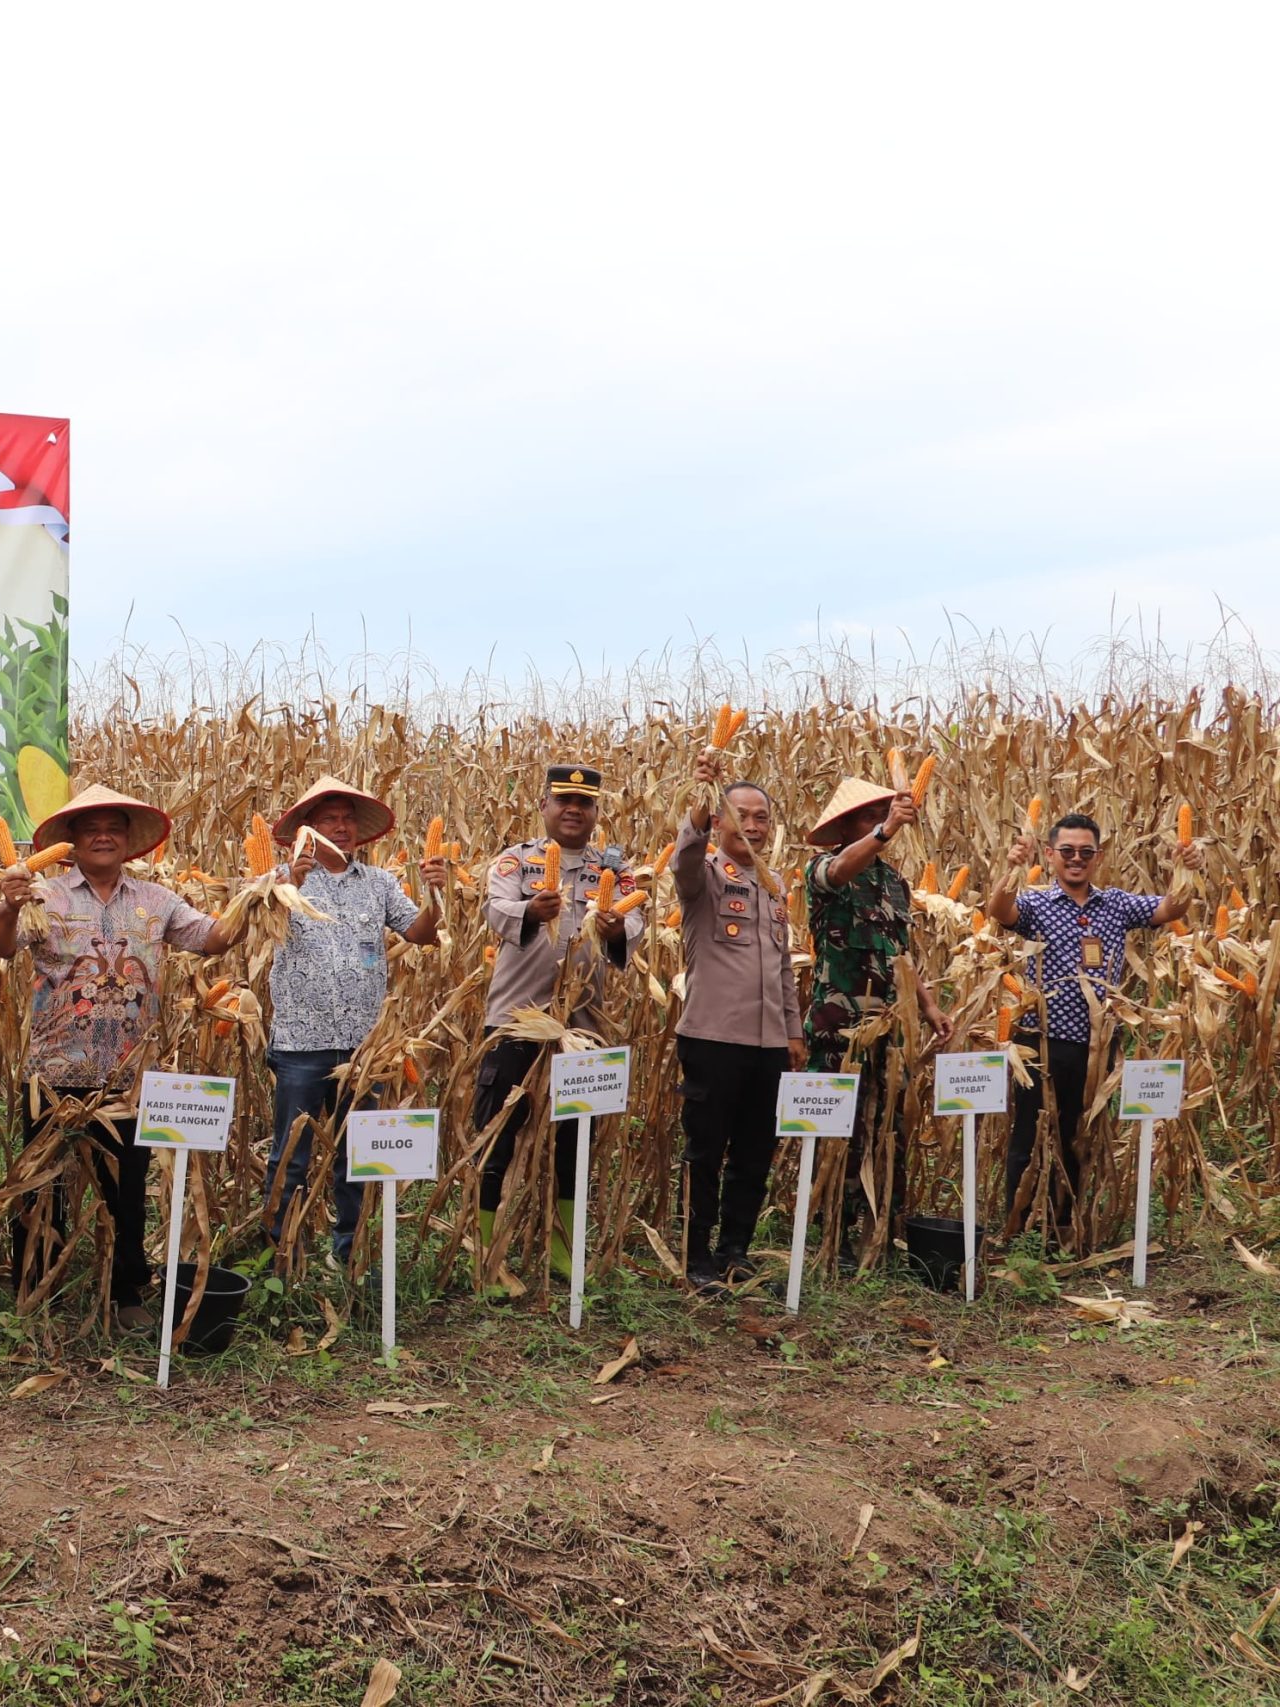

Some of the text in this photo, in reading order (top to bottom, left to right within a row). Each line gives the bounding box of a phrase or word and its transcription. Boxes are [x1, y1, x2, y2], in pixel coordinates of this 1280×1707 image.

[563, 1073, 617, 1086] KABAG SDM
[949, 1074, 992, 1084] DANRAMIL
[557, 1082, 623, 1097] POLRES LANGKAT
[954, 1085, 986, 1095] STABAT
[1140, 1081, 1164, 1089] CAMAT
[1138, 1091, 1165, 1099] STABAT
[792, 1096, 841, 1105] KAPOLSEK
[146, 1100, 226, 1113] KADIS PERTANIAN
[798, 1107, 834, 1116] STABAT
[149, 1114, 220, 1126] KAB. LANGKAT
[371, 1139, 413, 1150] BULOG
